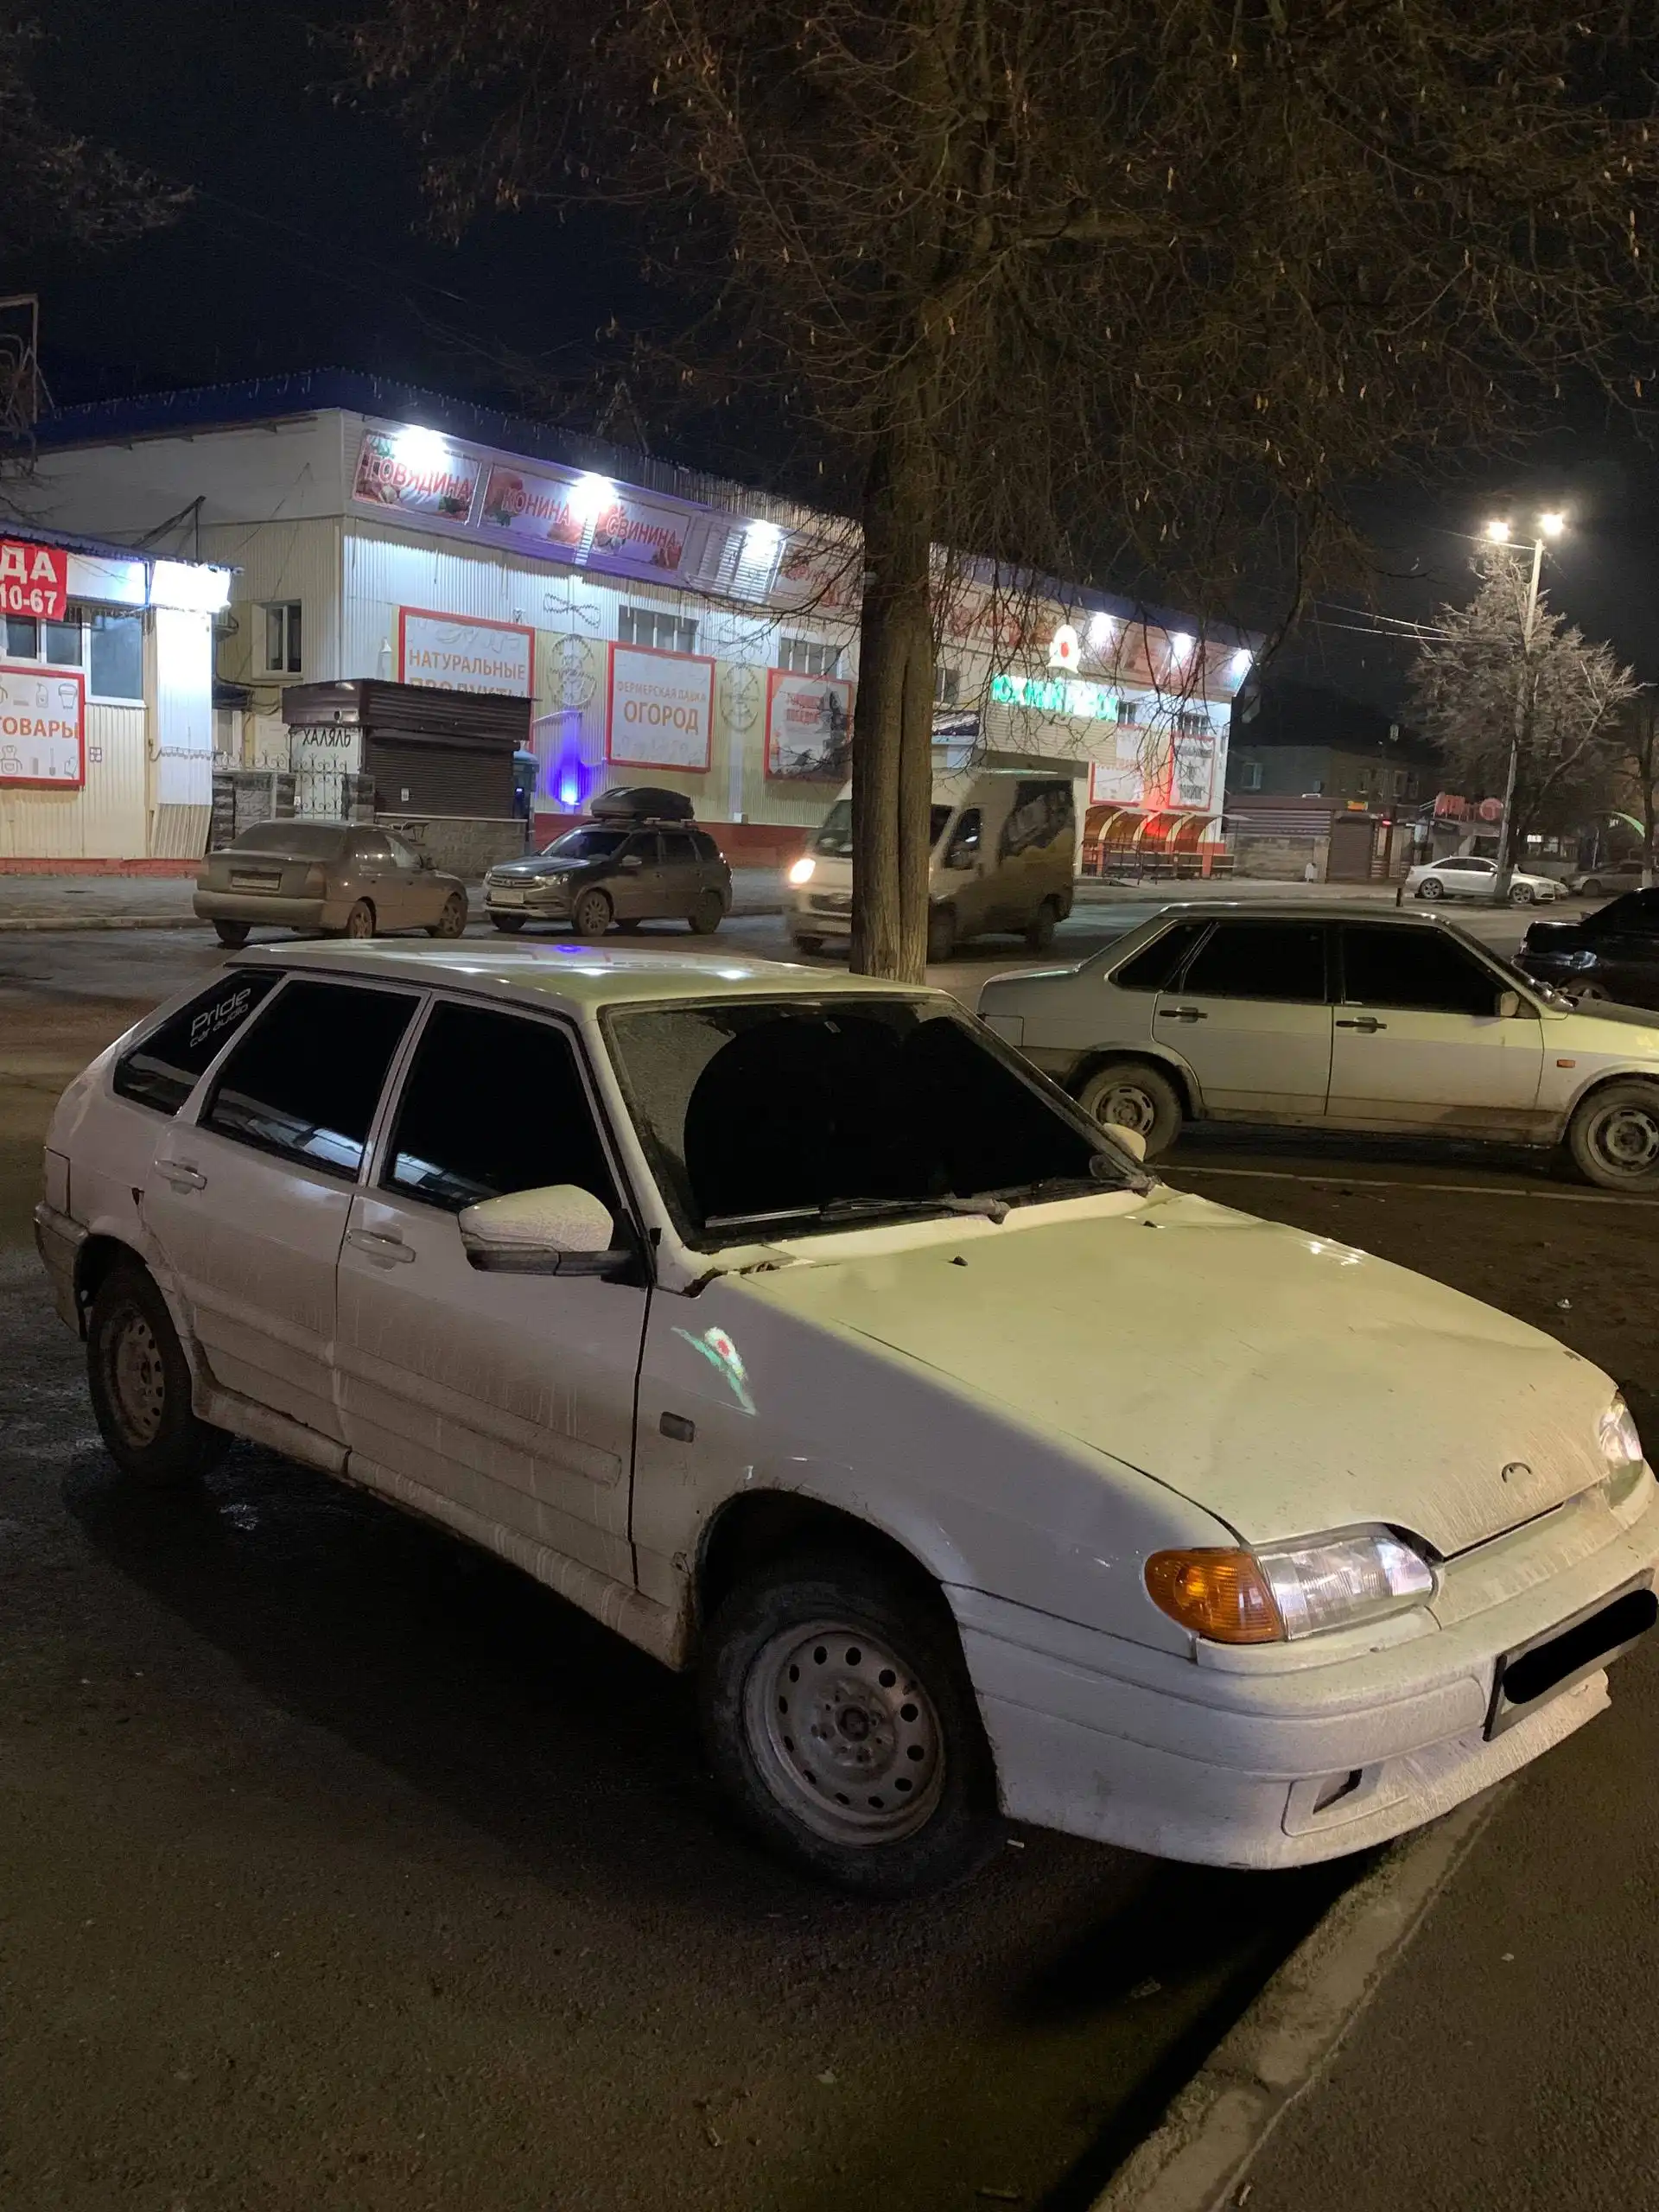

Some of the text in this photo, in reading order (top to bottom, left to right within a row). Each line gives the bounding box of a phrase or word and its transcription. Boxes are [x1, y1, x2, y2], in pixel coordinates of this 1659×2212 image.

[366, 453, 473, 500] ГОВЯДИНА
[501, 486, 571, 526] КОНИНА
[607, 515, 680, 550] СВИНИНА
[0, 545, 57, 584] ДА
[0, 583, 57, 615] 10-67
[409, 649, 526, 680] НАТУРАЛЬНЫЕ
[0, 715, 80, 740] ОВАРЫ
[624, 700, 698, 735] ОГОРОД
[302, 728, 352, 748] ХАЛЯЛЬ
[191, 988, 251, 1037] Pride
